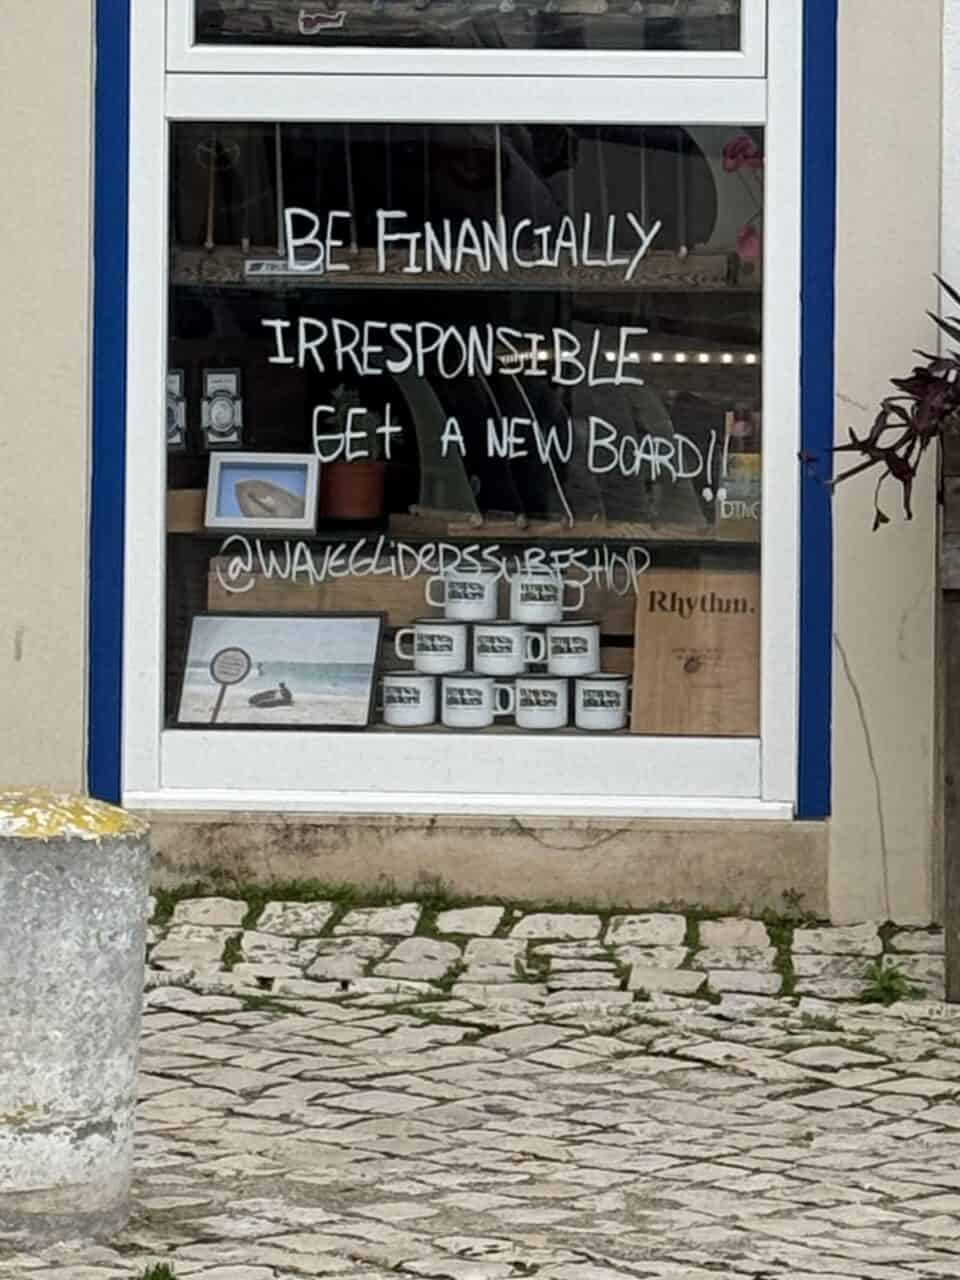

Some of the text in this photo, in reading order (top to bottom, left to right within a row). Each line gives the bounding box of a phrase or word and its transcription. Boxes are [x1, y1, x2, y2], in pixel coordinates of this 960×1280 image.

[284, 207, 662, 280] BE FINANCIALLY
[261, 316, 649, 387] IRRESPONSIBLE
[440, 416, 467, 458] A
[486, 416, 574, 464] NEW
[648, 589, 756, 619] Rhythm.
